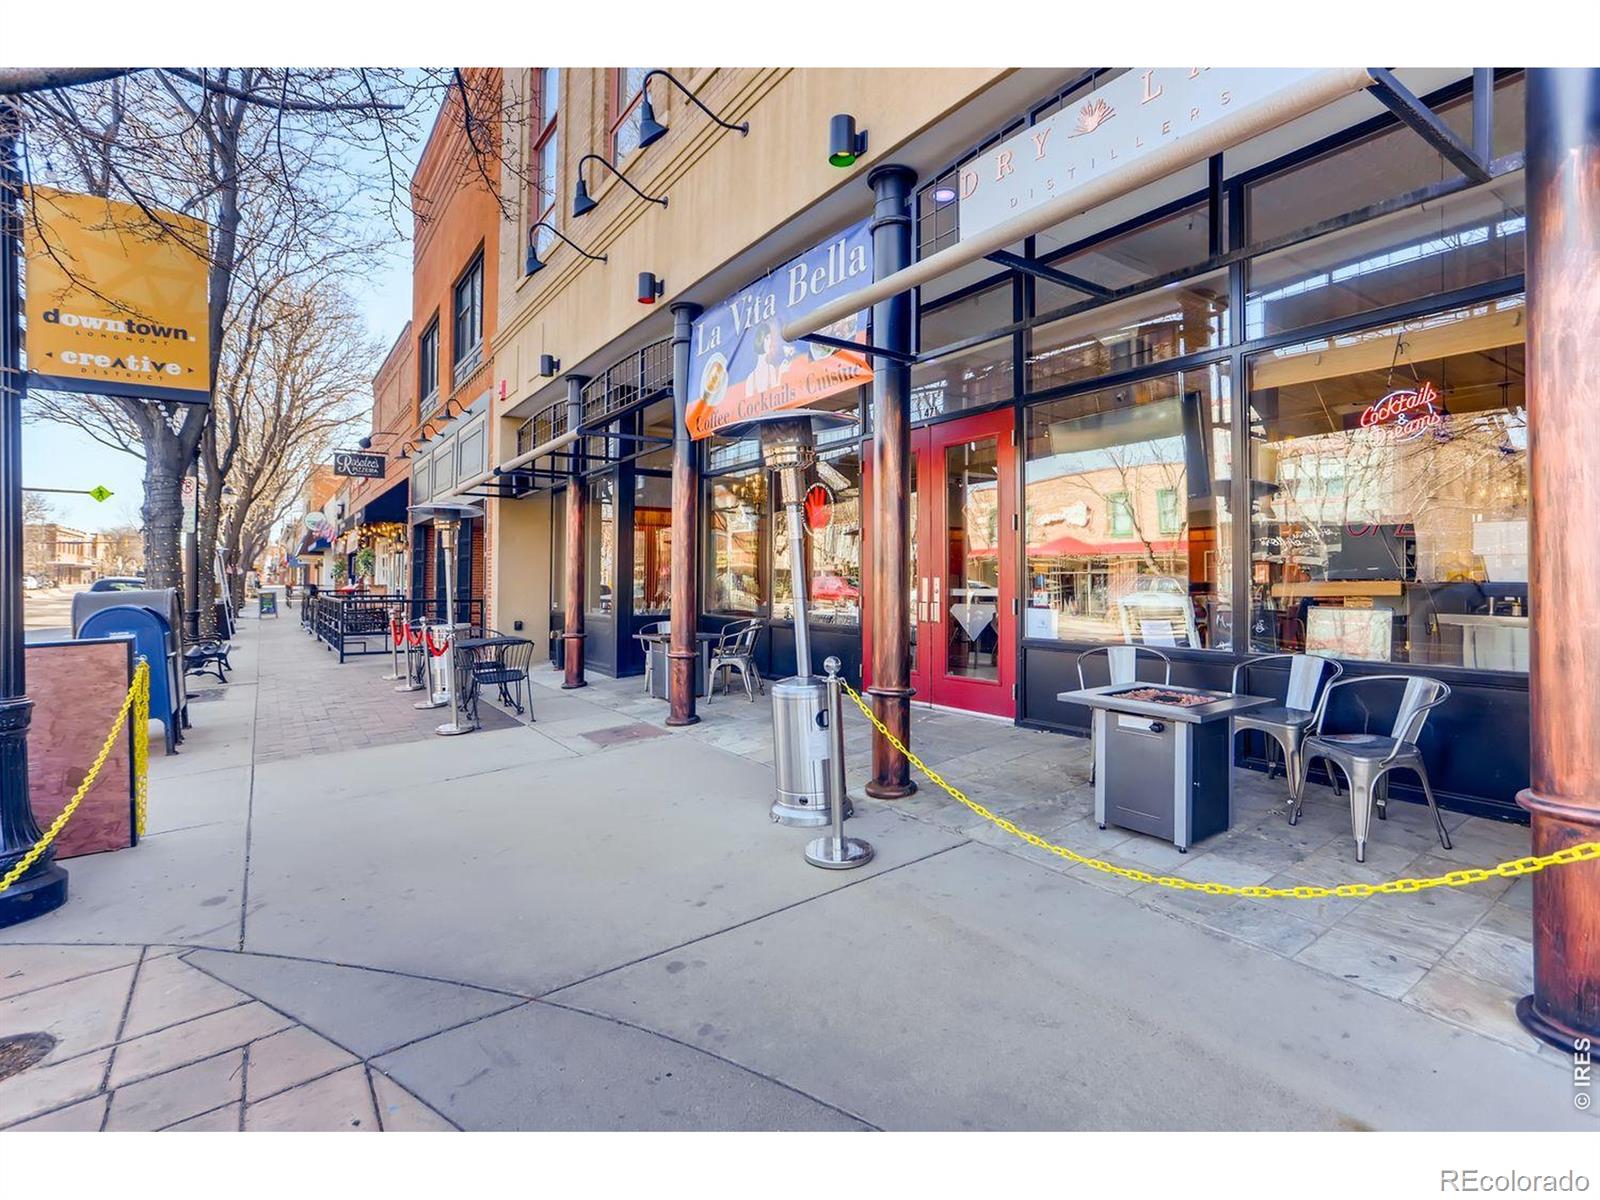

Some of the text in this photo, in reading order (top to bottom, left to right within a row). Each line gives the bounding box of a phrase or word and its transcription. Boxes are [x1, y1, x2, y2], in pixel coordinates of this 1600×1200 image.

[960, 127, 1051, 201] DRY
[1009, 90, 1231, 209] DISTILLERS
[696, 238, 868, 357] La Vita Bella
[75, 331, 169, 345] LONGMONT
[81, 368, 164, 381] DISTRICT
[696, 363, 861, 433] Coffee Cocktails Cuisine
[1360, 382, 1437, 427] Cocktails
[1397, 413, 1408, 425] &
[1374, 411, 1441, 447] Dreams
